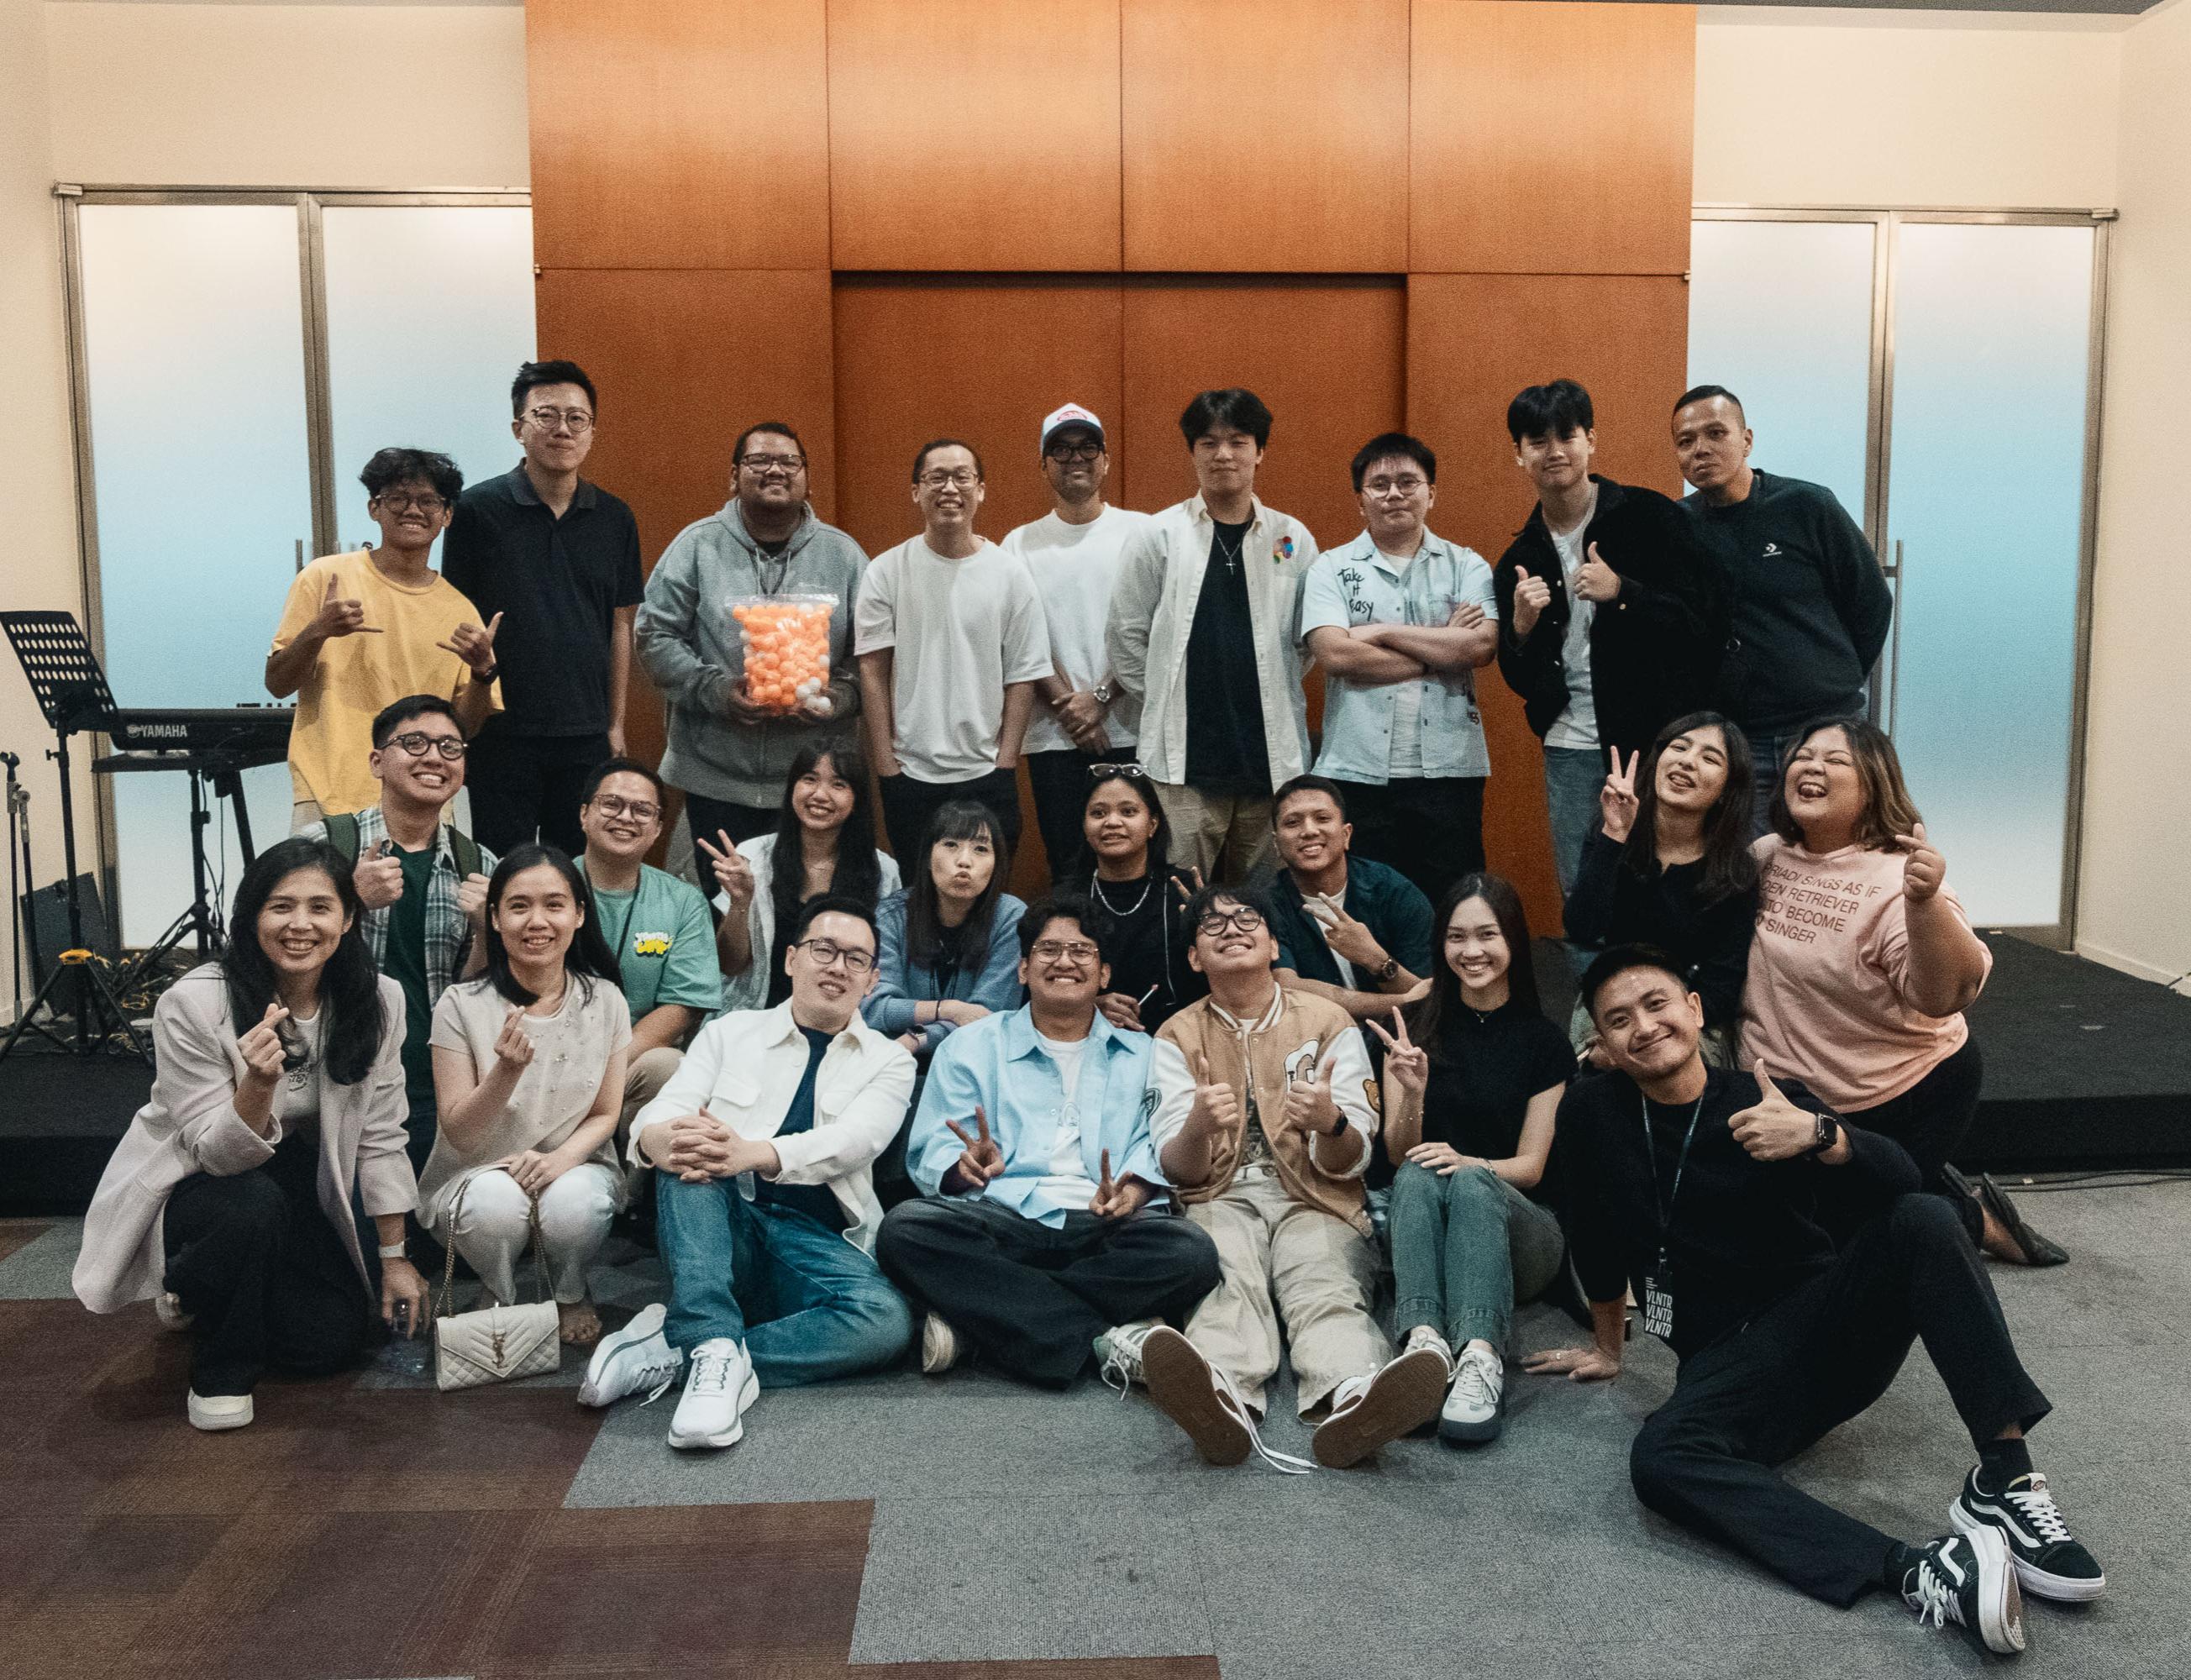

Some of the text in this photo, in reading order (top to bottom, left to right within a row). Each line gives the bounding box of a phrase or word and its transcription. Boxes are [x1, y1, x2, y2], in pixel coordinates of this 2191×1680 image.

[1337, 567, 1365, 586] Take
[140, 725, 187, 738] YAMAHA
[1801, 875, 1842, 890] SINGS
[1842, 882, 1863, 897] AS
[1865, 885, 1882, 898] IF
[1787, 887, 1860, 915] RETRIEVER
[1765, 898, 1784, 914] TO
[1786, 906, 1847, 932] BECOME
[1765, 918, 1817, 944] SINGER
[1646, 1289, 1673, 1309] VLNTR
[1647, 1303, 1673, 1324] VLNTR
[1645, 1317, 1673, 1338] VLNTR
